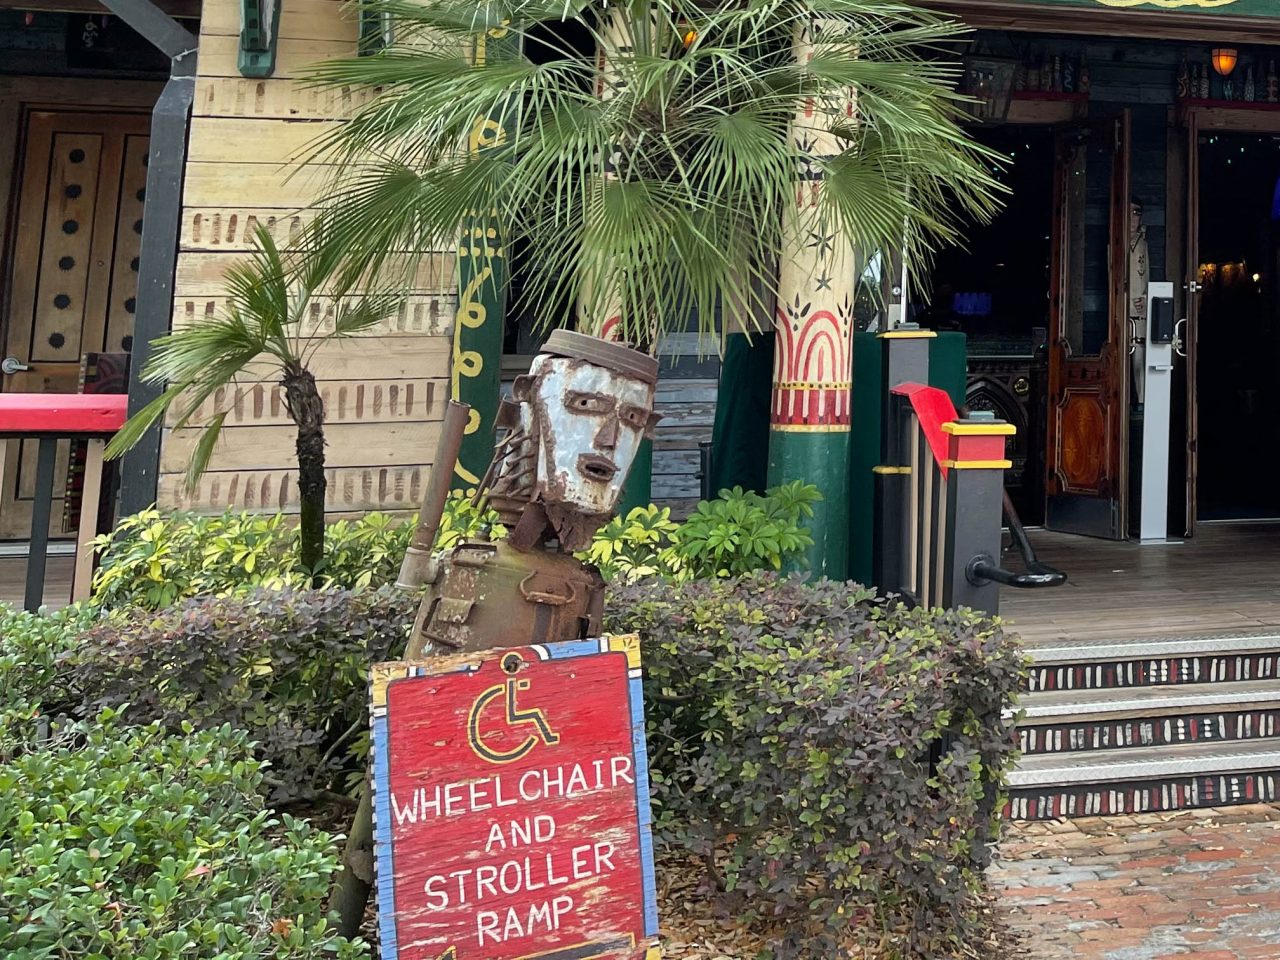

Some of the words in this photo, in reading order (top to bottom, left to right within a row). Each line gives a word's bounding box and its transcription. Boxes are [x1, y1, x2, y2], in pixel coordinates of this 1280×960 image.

[485, 815, 556, 852] AND
[424, 841, 616, 911] STROLLER
[477, 895, 574, 947] RAMP
